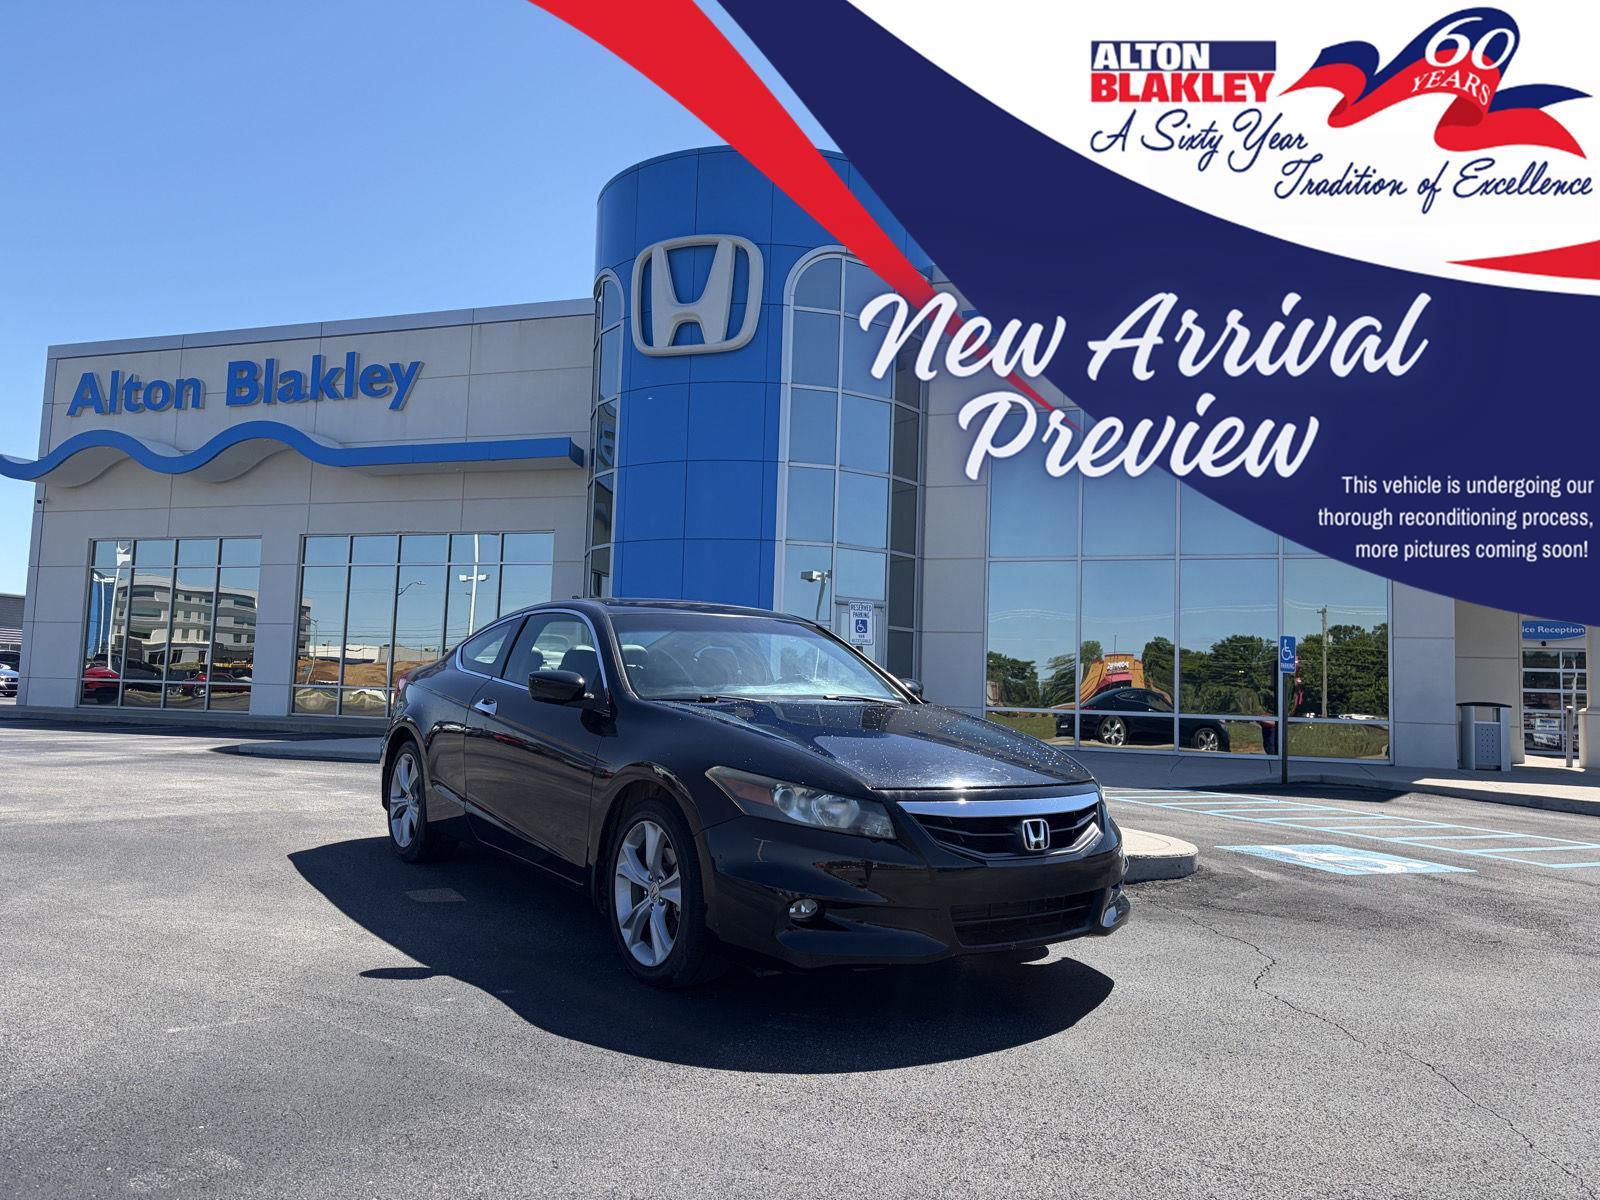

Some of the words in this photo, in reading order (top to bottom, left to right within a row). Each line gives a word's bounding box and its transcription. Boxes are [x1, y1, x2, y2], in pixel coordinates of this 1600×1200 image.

[66, 369, 206, 417] Alton
[226, 351, 424, 411] Blakley
[1537, 625, 1585, 635] Reception
[1280, 662, 1296, 670] PARKING
